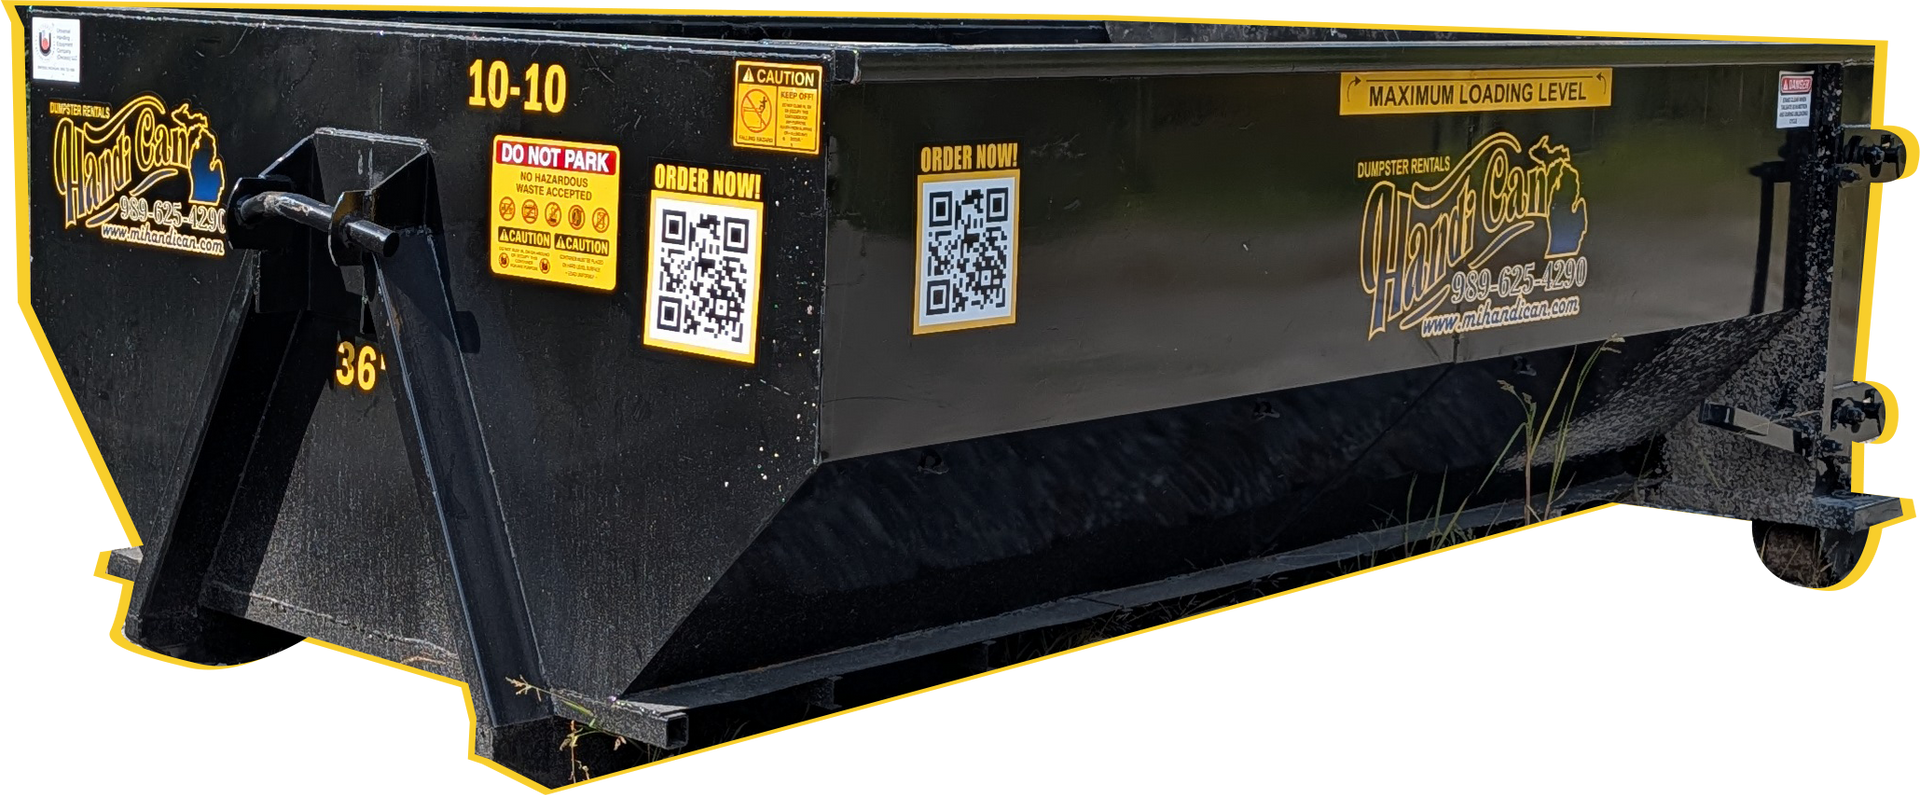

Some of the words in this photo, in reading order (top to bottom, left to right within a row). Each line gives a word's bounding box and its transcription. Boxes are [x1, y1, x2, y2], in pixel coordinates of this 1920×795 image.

[469, 59, 566, 113] 10-10
[757, 68, 815, 87] CAUTION
[780, 91, 797, 99] KEEP
[1369, 84, 1454, 107] MAXIMUM
[1459, 83, 1533, 105] LOADING
[1538, 81, 1587, 102] LEVEL
[50, 102, 82, 116] DUMPSTER
[83, 105, 110, 119] RENTALS
[54, 117, 132, 229] Handi
[135, 107, 190, 172] Can
[501, 142, 524, 163] DO
[528, 145, 561, 168] NOT
[564, 149, 610, 173] PARK
[921, 144, 973, 173] ORDER
[976, 142, 1018, 169] NOW!
[1357, 158, 1409, 178] DUMPSTER
[1410, 155, 1450, 174] RENTALS
[516, 183, 544, 196] WASTE
[546, 187, 592, 201] ACCEPTED
[520, 171, 532, 181] NO
[535, 173, 588, 188] HAZARDOUS
[654, 163, 709, 194] ORDER
[713, 169, 762, 200] NOW!
[101, 223, 225, 256] www.mihandican.com
[509, 229, 550, 247] CAUTION
[566, 237, 608, 255] CAUTION
[1360, 175, 1476, 341] Handi
[1481, 147, 1548, 233] Can
[1451, 256, 1588, 303] 989-625-4290
[1421, 295, 1580, 337] www.mihandican.com
